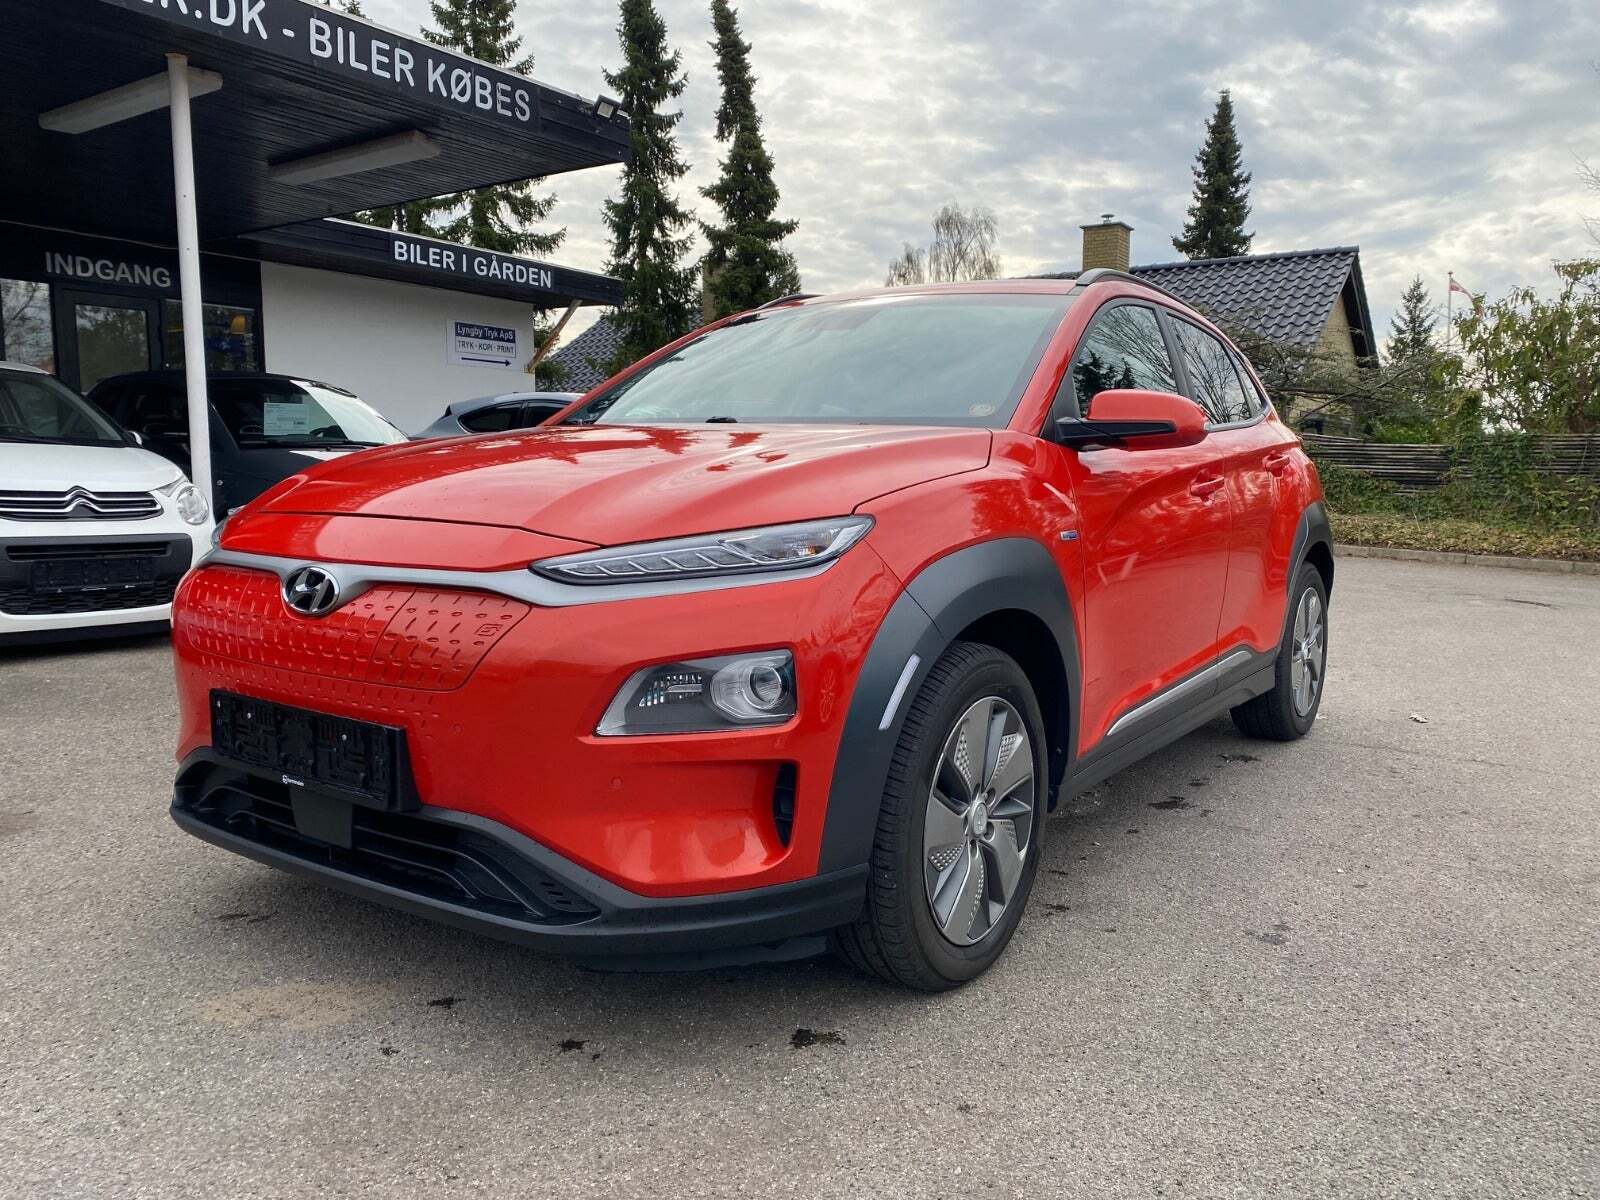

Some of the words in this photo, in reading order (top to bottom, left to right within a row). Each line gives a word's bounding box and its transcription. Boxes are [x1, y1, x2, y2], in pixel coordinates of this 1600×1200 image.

[309, 18, 415, 87] BILER
[427, 58, 530, 122] KØBES
[45, 251, 171, 288] INDGANG
[394, 240, 455, 272] BILER
[462, 254, 467, 273] I
[474, 254, 552, 289] GÅRDEN
[457, 324, 483, 337] Lyngby
[484, 327, 499, 339] Tryk
[499, 330, 514, 340] ApS
[458, 340, 474, 350] TRYK
[478, 343, 493, 352] KOPI
[497, 345, 514, 353] PRINT
